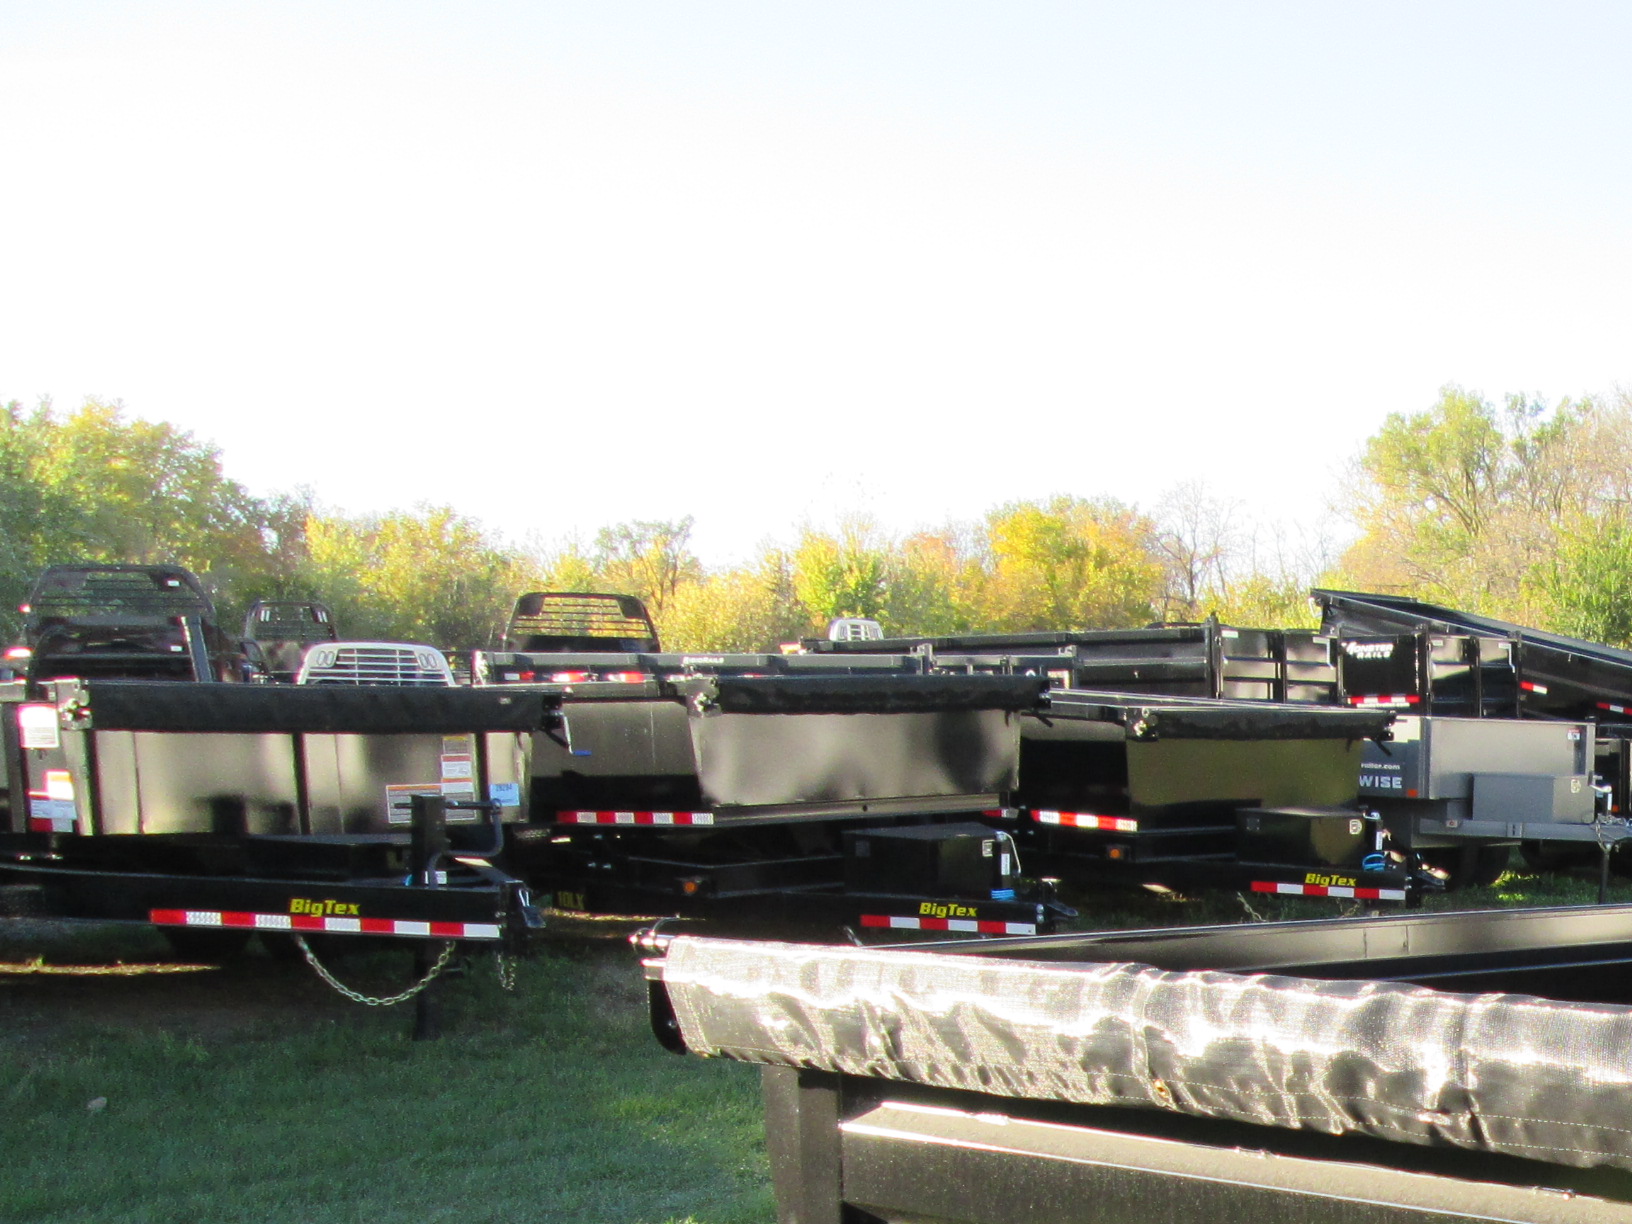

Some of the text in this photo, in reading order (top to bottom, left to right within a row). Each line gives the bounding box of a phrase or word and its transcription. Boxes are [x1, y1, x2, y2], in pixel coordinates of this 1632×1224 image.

[1359, 775, 1403, 789] WISE
[1304, 873, 1357, 888] BigTex
[289, 898, 360, 918] BigTex
[919, 902, 978, 918] BigTex
